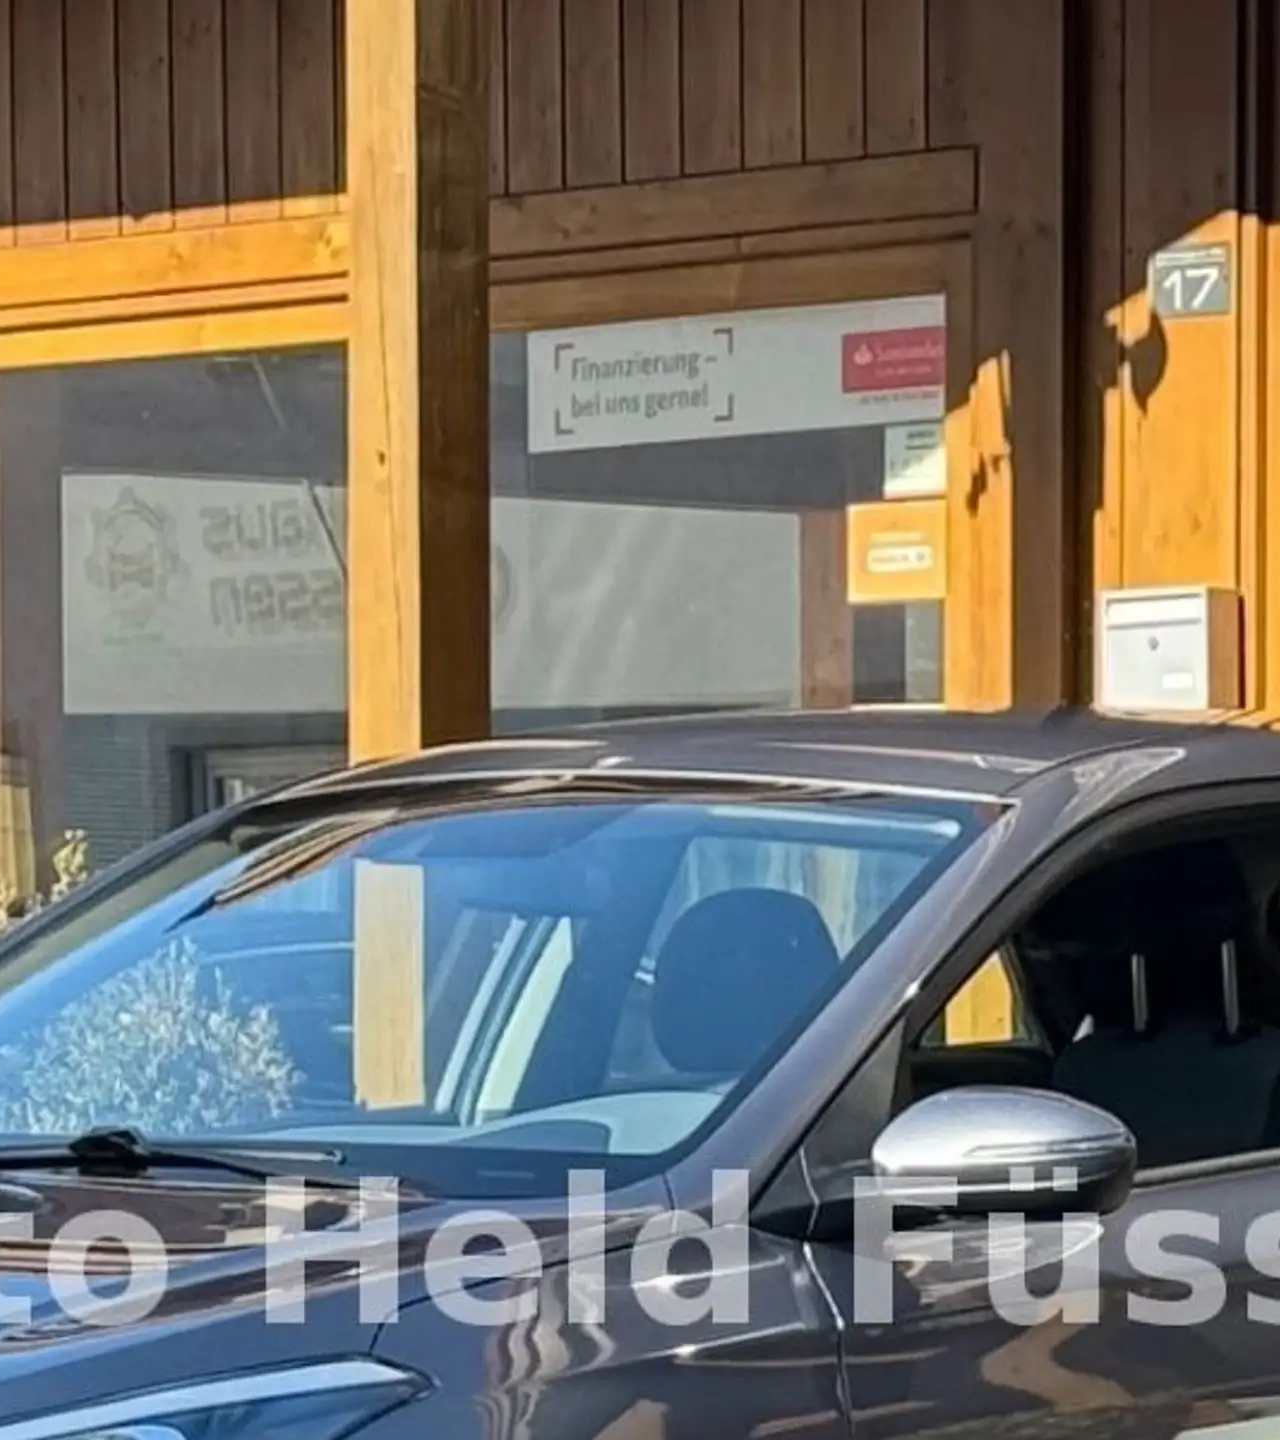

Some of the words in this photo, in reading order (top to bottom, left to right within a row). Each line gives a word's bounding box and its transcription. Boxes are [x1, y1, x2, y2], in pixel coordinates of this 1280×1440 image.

[1162, 267, 1219, 310] 17
[572, 350, 701, 381] Finanzierung
[572, 389, 600, 418] bei
[605, 393, 641, 415] uns
